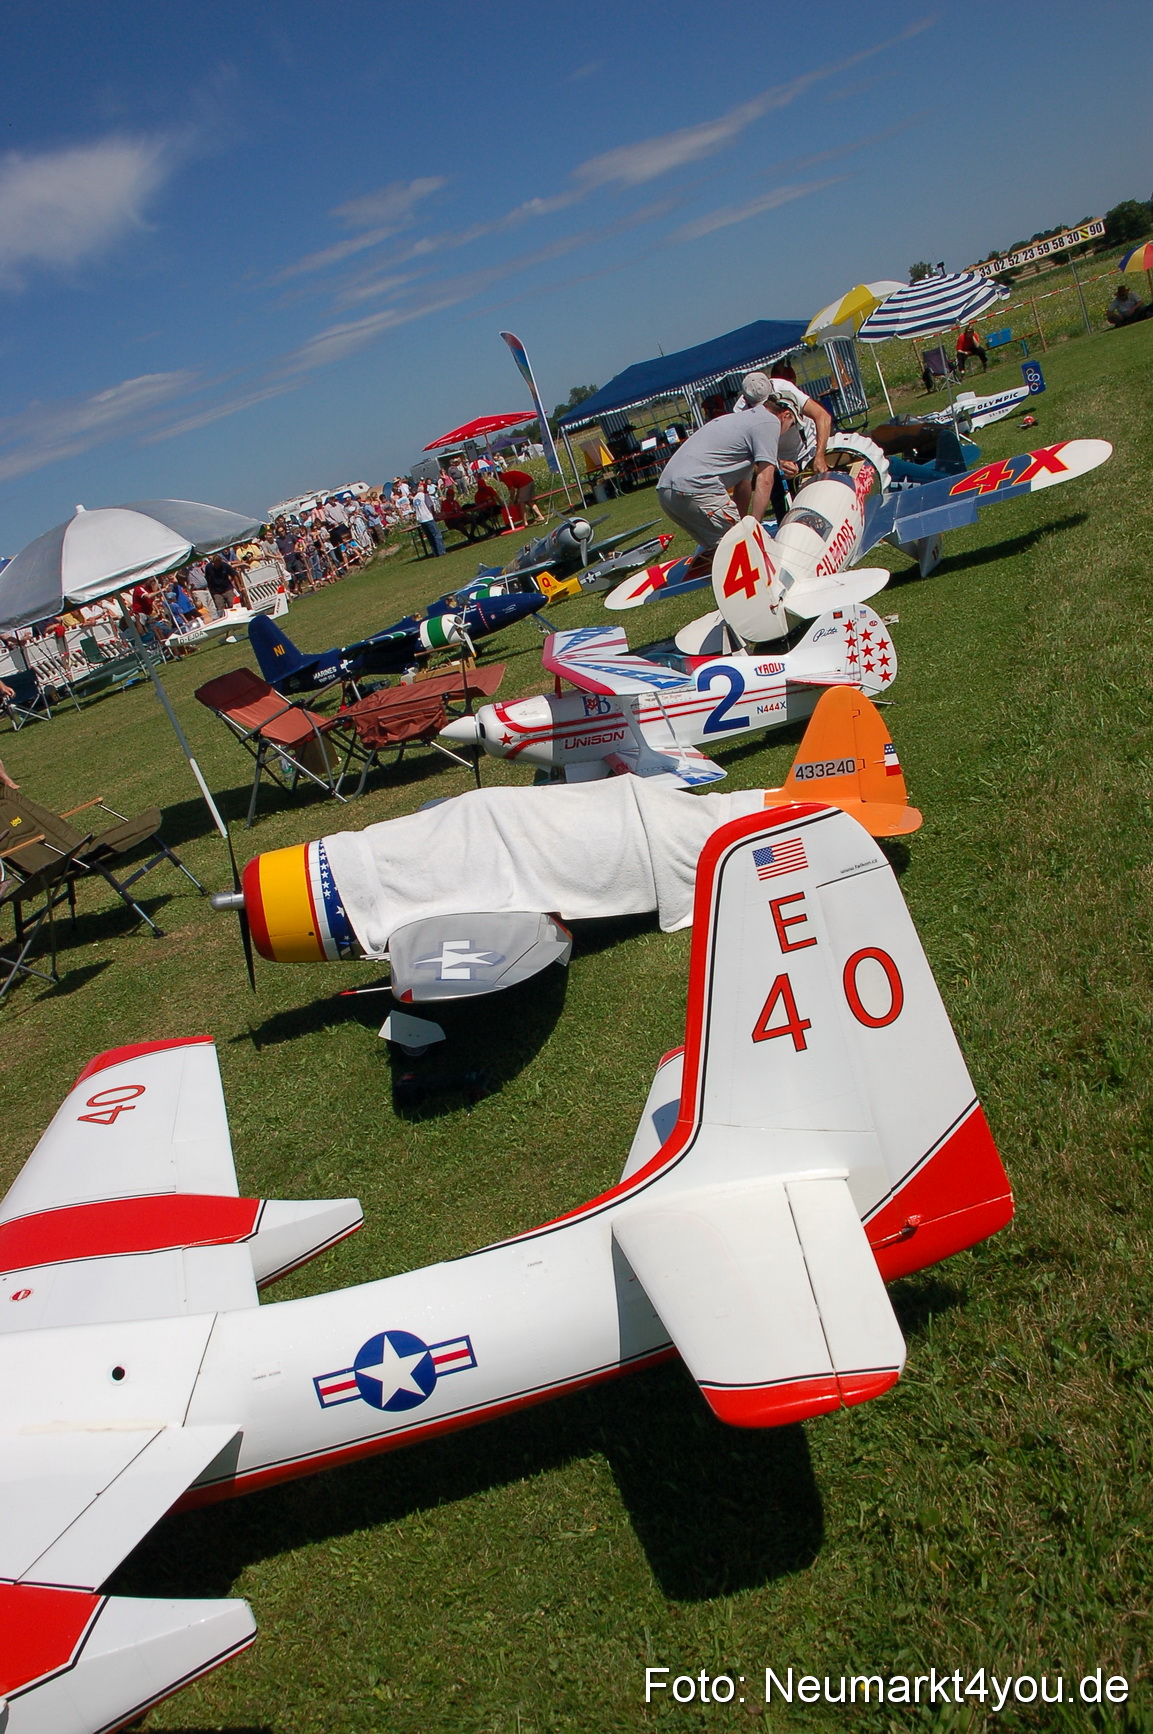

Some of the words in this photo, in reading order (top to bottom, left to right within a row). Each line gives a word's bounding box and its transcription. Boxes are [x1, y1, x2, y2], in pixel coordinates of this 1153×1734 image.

[979, 266, 992, 277] 33
[994, 260, 1006, 272] 02
[1008, 254, 1021, 267] 52
[1022, 248, 1035, 261] 23
[1037, 242, 1050, 255] 59
[1052, 238, 1065, 250] 58
[1066, 231, 1080, 244] 30
[1089, 223, 1103, 235] 90
[977, 391, 1019, 410] OLYMPIC
[948, 440, 1073, 496] 4X
[722, 523, 777, 600] 4X
[815, 518, 857, 577] GILMORE
[541, 576, 552, 588] Q
[312, 665, 337, 681] MARINES
[753, 662, 786, 676] TYROLIT
[696, 664, 751, 735] 2
[756, 701, 787, 715] N444X
[795, 759, 856, 780] 433240
[768, 891, 818, 955] E
[76, 1084, 147, 1125] 40
